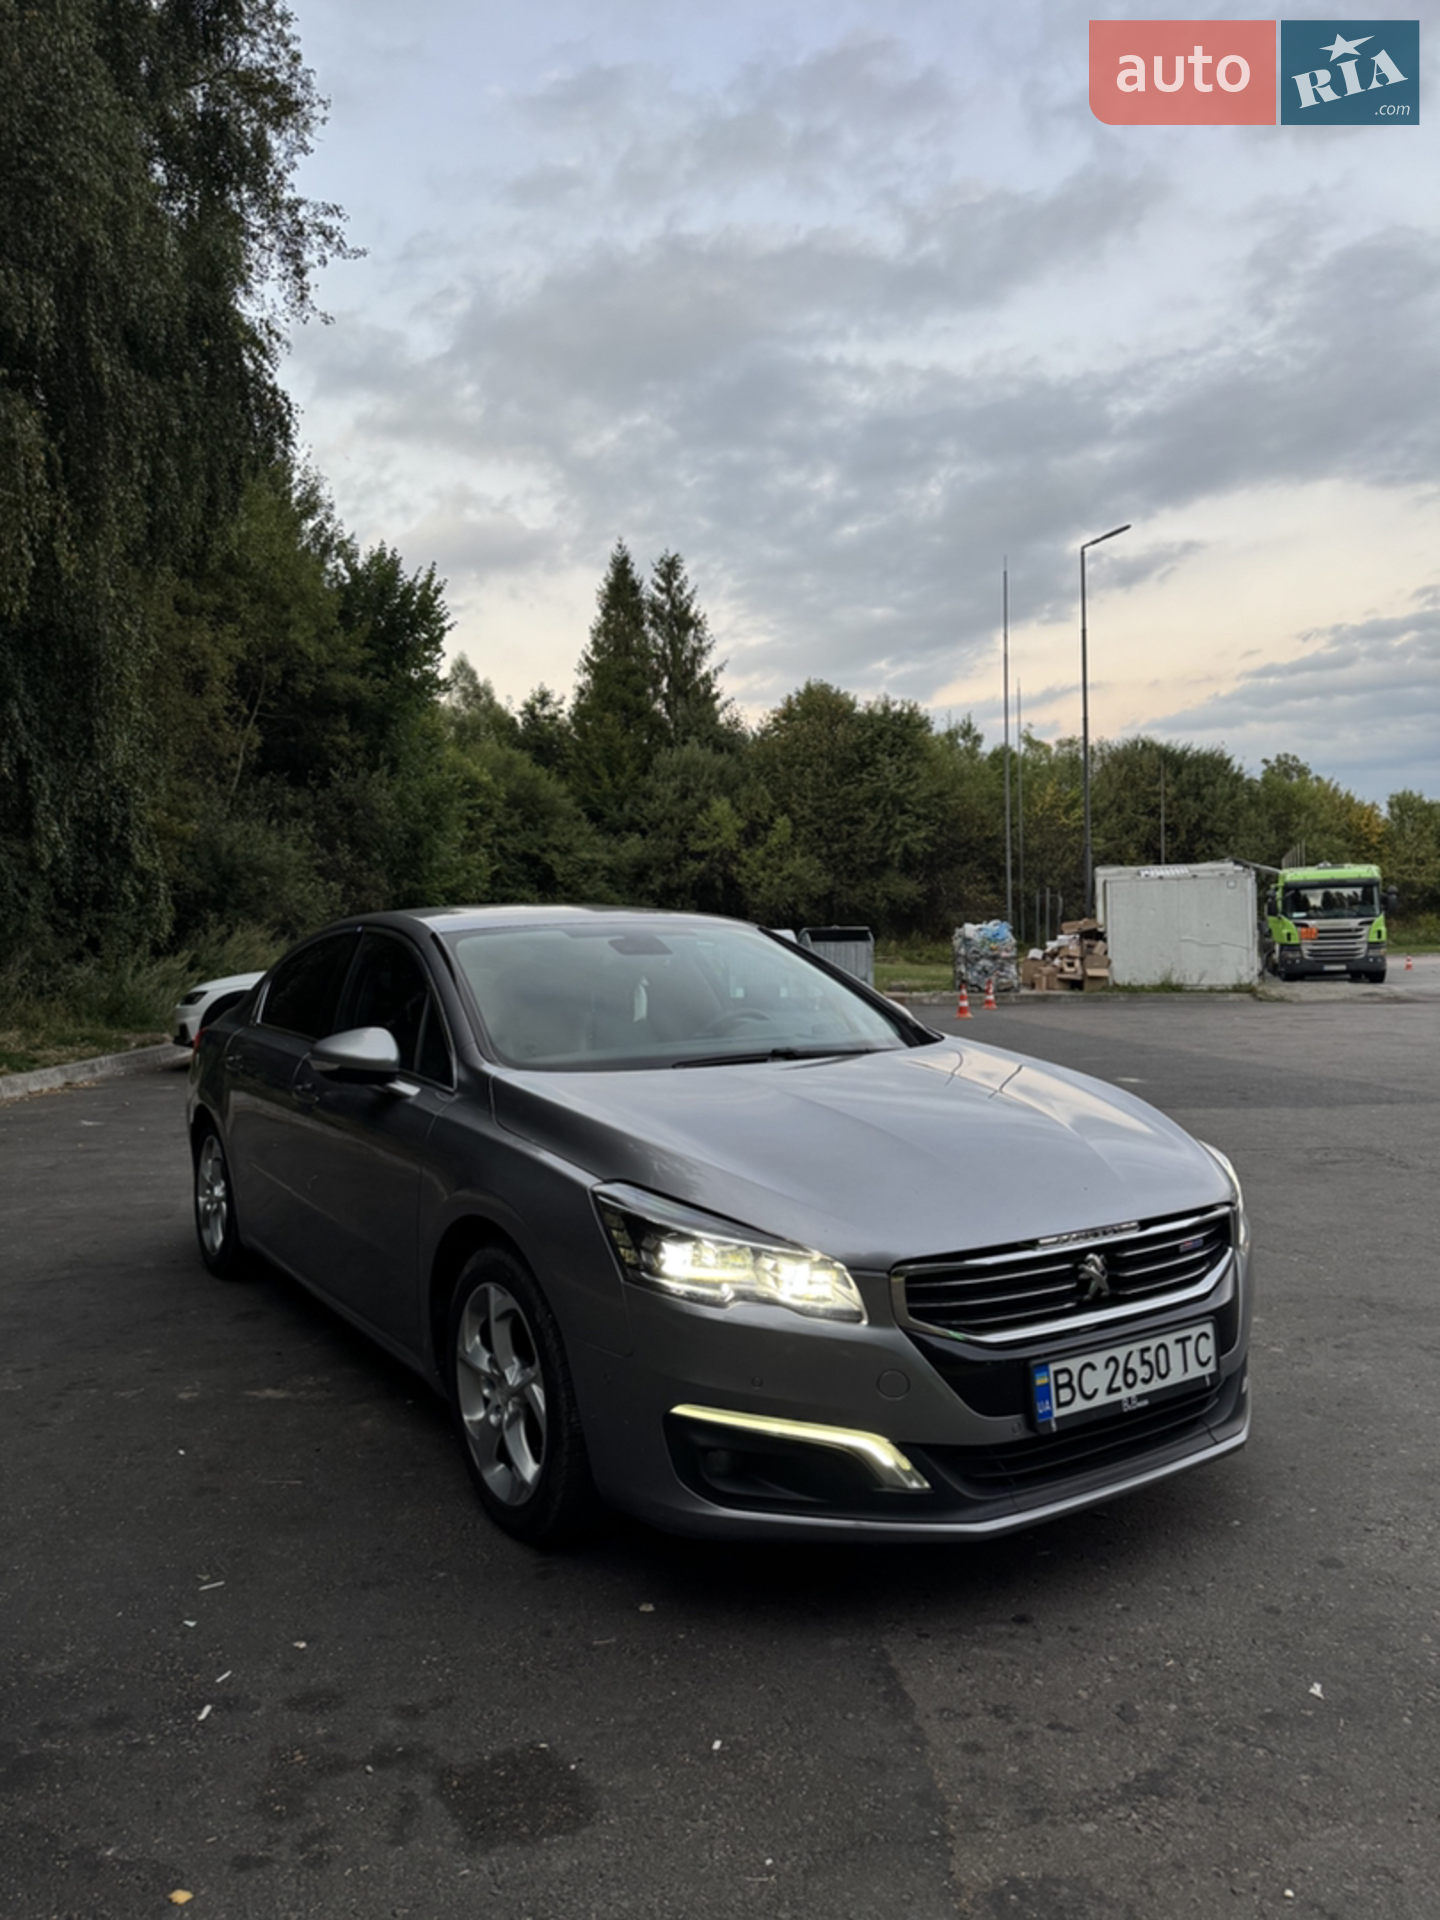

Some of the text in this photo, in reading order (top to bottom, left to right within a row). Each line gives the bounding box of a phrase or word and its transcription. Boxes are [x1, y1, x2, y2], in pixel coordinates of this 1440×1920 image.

[1053, 1331, 1212, 1409] BC 2650 TC
